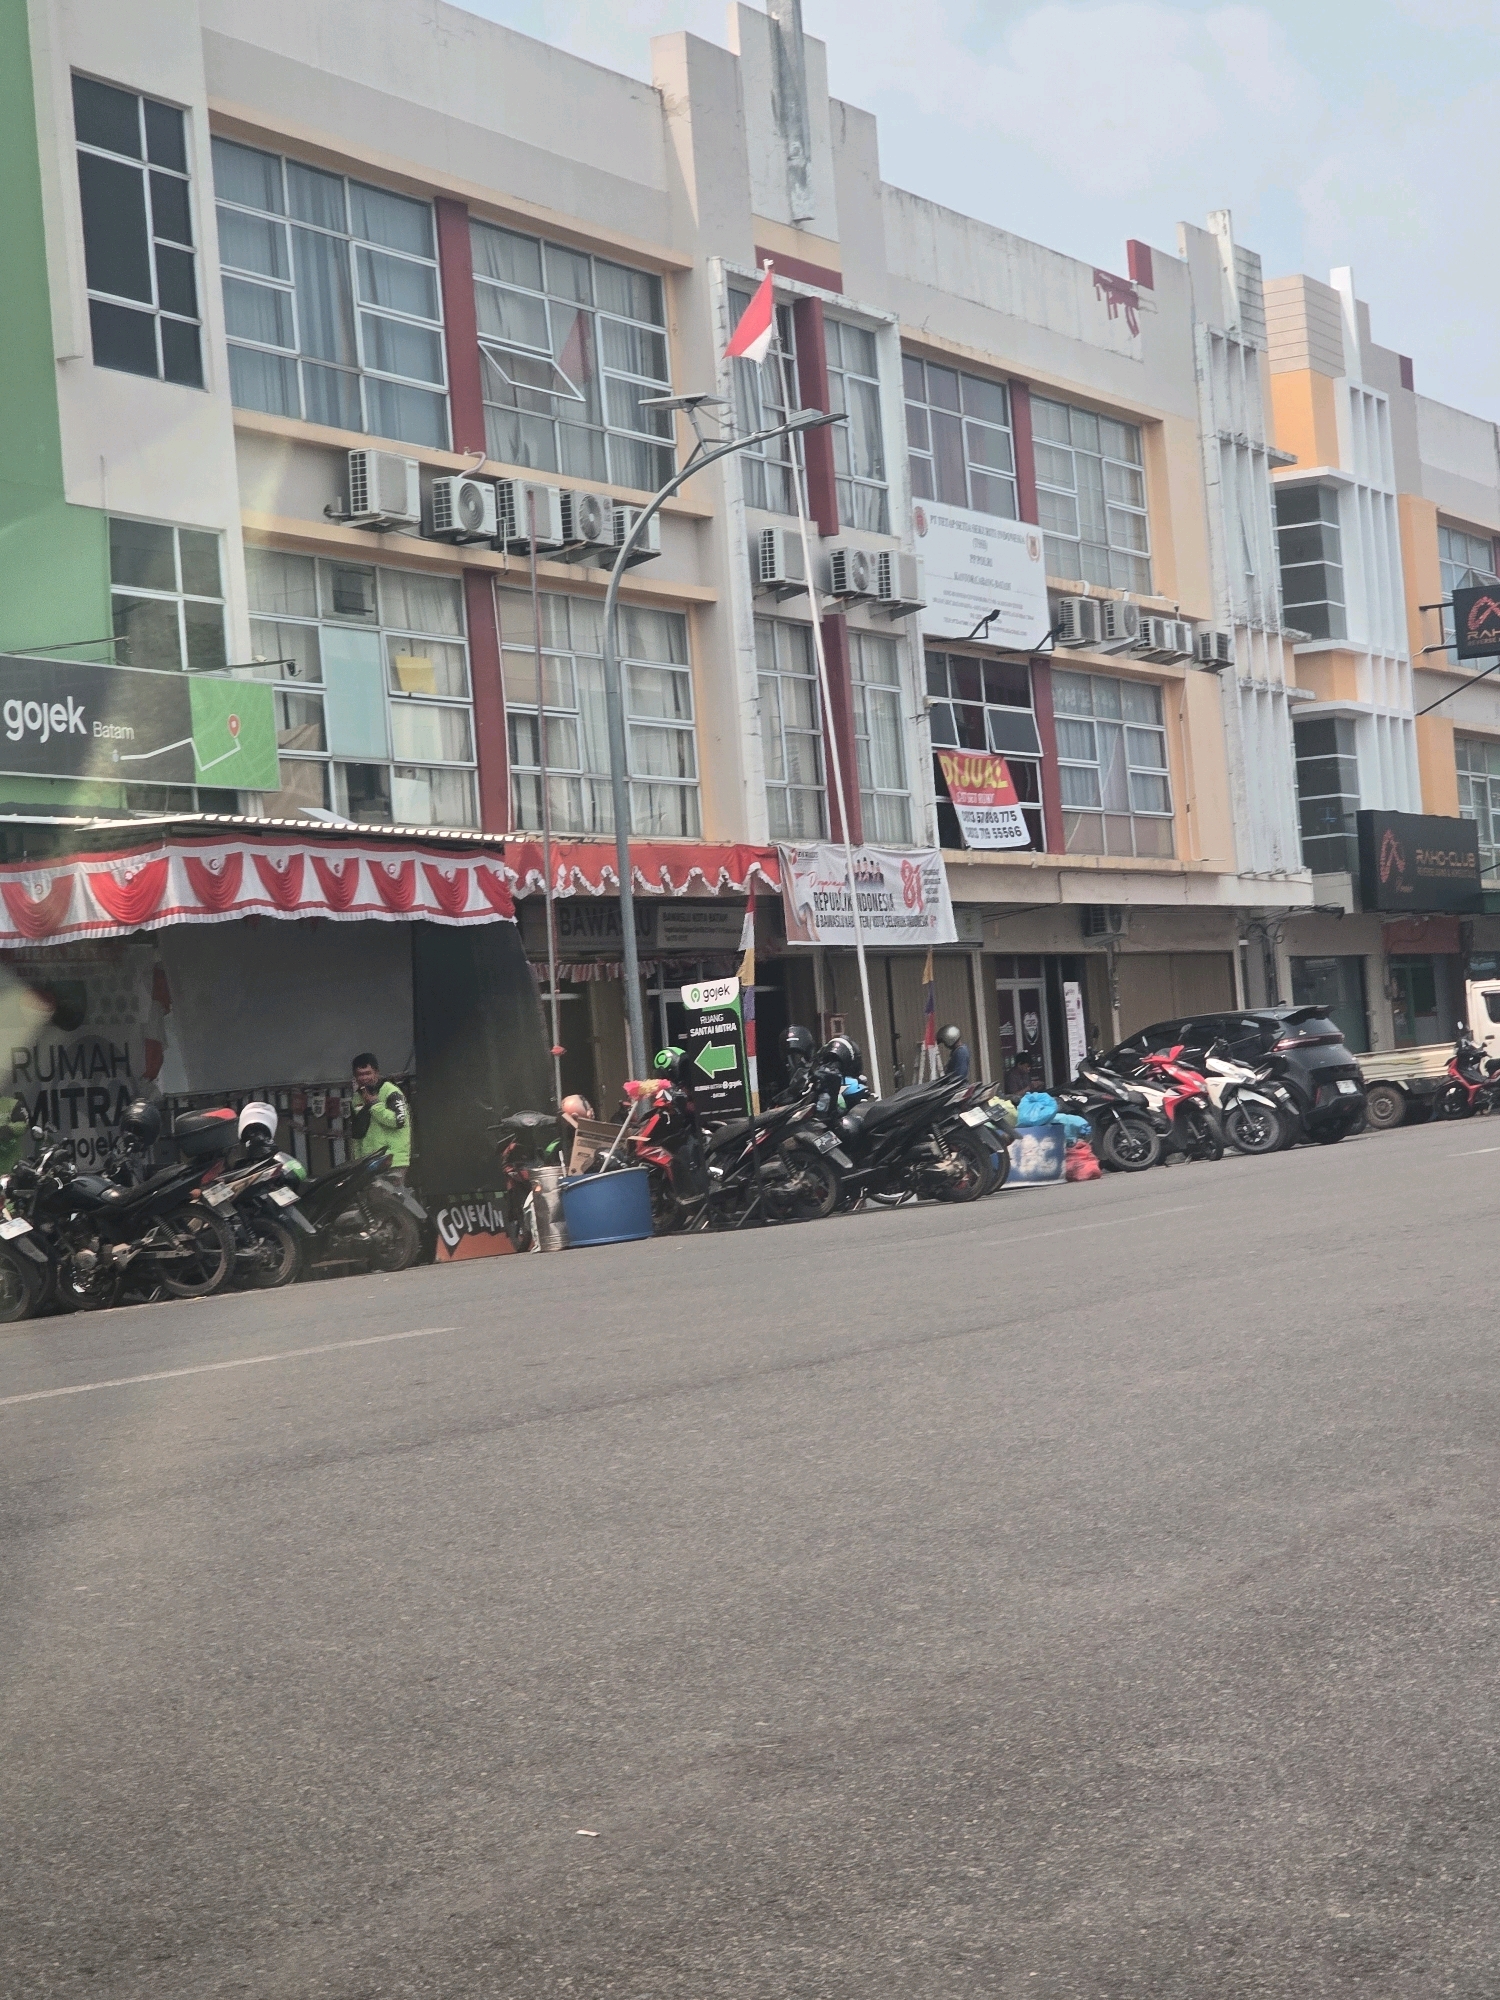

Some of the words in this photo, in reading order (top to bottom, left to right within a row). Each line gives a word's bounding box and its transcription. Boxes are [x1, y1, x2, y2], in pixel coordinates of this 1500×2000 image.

[3, 695, 87, 743] gojek
[92, 720, 135, 740] Batam
[939, 755, 1008, 789] DIJUAL
[813, 891, 854, 912] REPUBLIK
[855, 892, 896, 912] NDONESIA
[559, 905, 651, 937] BAWAU
[702, 984, 731, 1002] gojek
[689, 1024, 715, 1038] SANTAI
[714, 1022, 738, 1034] MITRA
[700, 1013, 725, 1025] RUANG
[10, 1041, 132, 1084] RUMAH
[13, 1083, 133, 1131] MITRA
